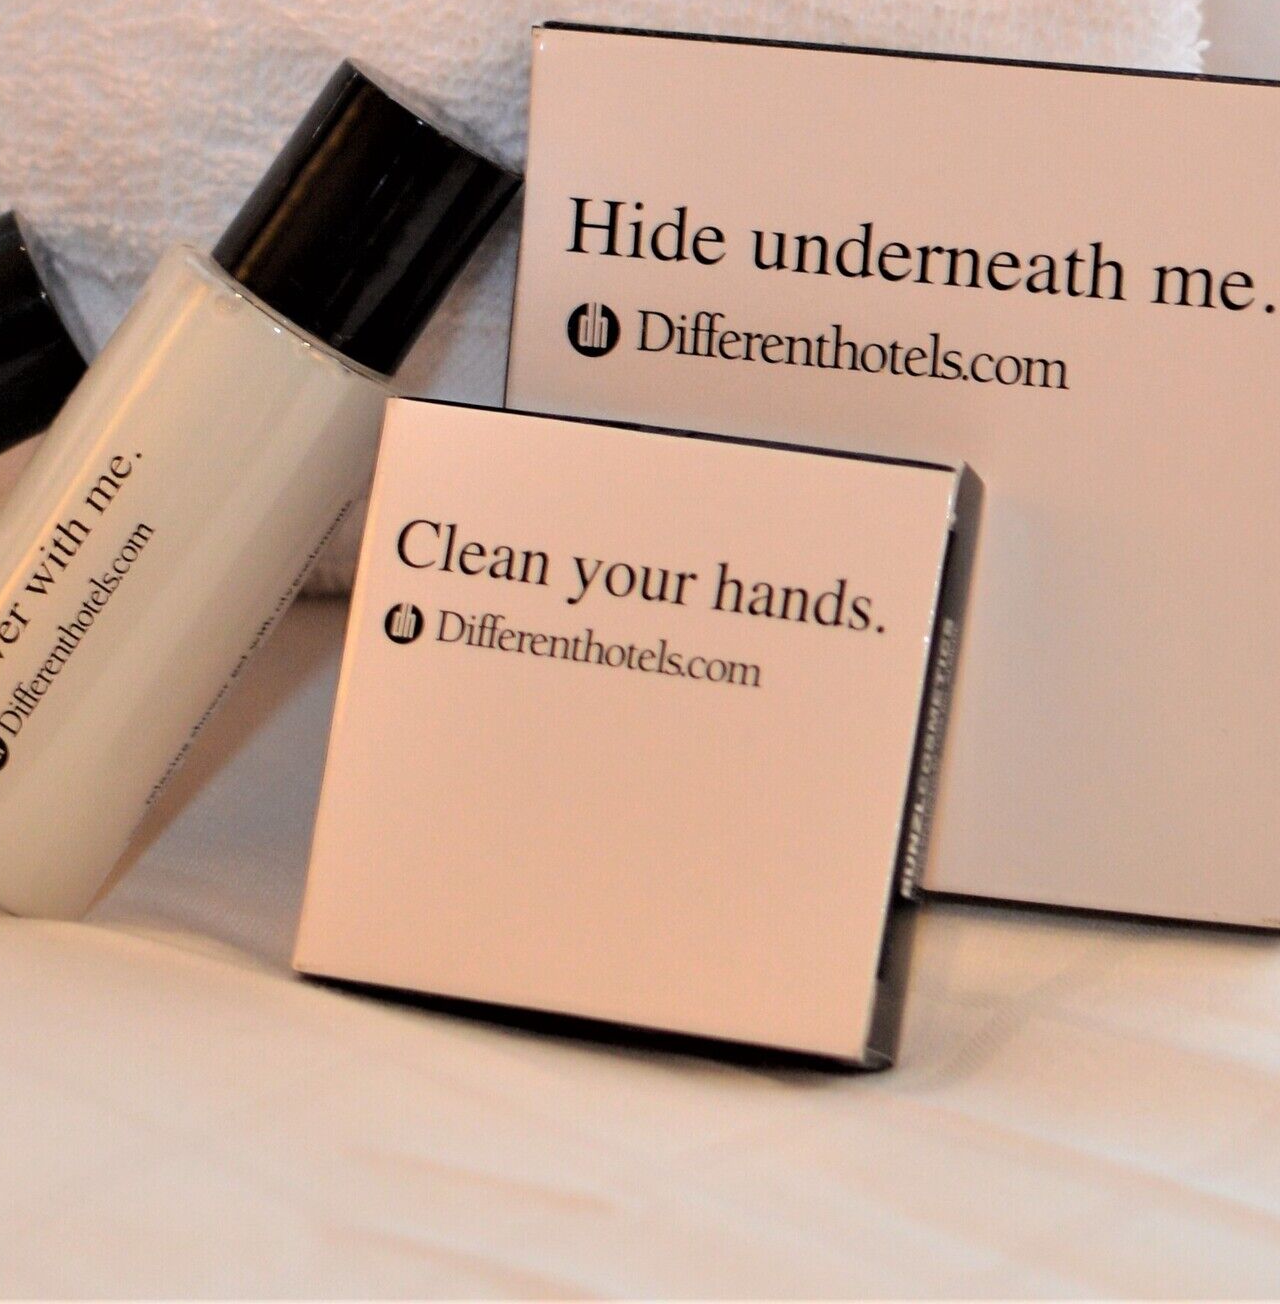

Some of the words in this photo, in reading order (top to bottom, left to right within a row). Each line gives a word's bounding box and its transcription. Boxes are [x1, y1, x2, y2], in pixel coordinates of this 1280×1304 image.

[566, 197, 726, 265] Hide
[751, 222, 1126, 301] underneath
[1150, 266, 1276, 314] me.
[637, 310, 1069, 390] Differenthotels.com
[25, 519, 92, 595] with
[85, 452, 143, 516] me.
[397, 520, 549, 586] Clean
[566, 557, 699, 606] your
[712, 562, 886, 635] hands.
[436, 610, 760, 687] Differenthotels.com
